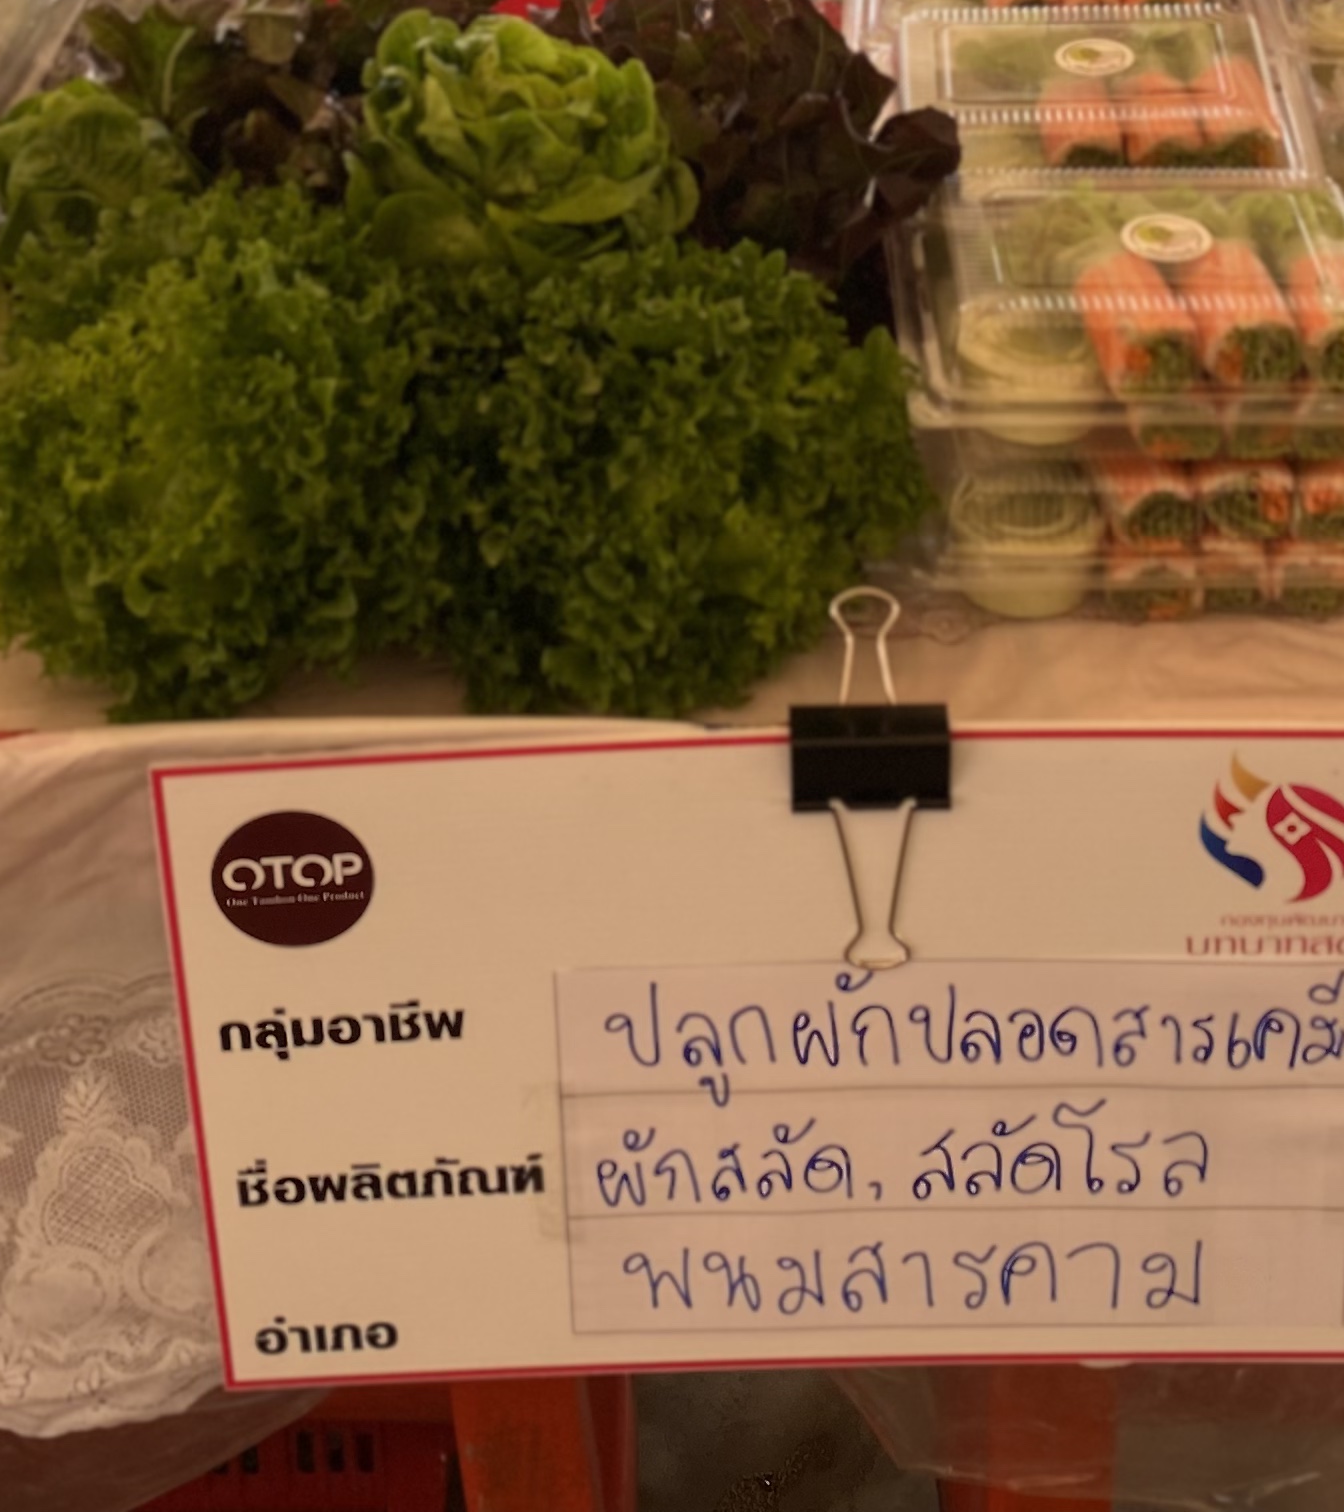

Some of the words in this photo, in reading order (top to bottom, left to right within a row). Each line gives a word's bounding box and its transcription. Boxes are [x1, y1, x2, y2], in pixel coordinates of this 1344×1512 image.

[221, 851, 364, 892] OTOP
[218, 998, 465, 1061] กลุ่มอาชีพ
[236, 1152, 546, 1208] ชื่อผลิตภัณฑ์
[622, 1239, 1203, 1315] พนมสารคาม
[255, 1315, 399, 1356] อำเภอ
